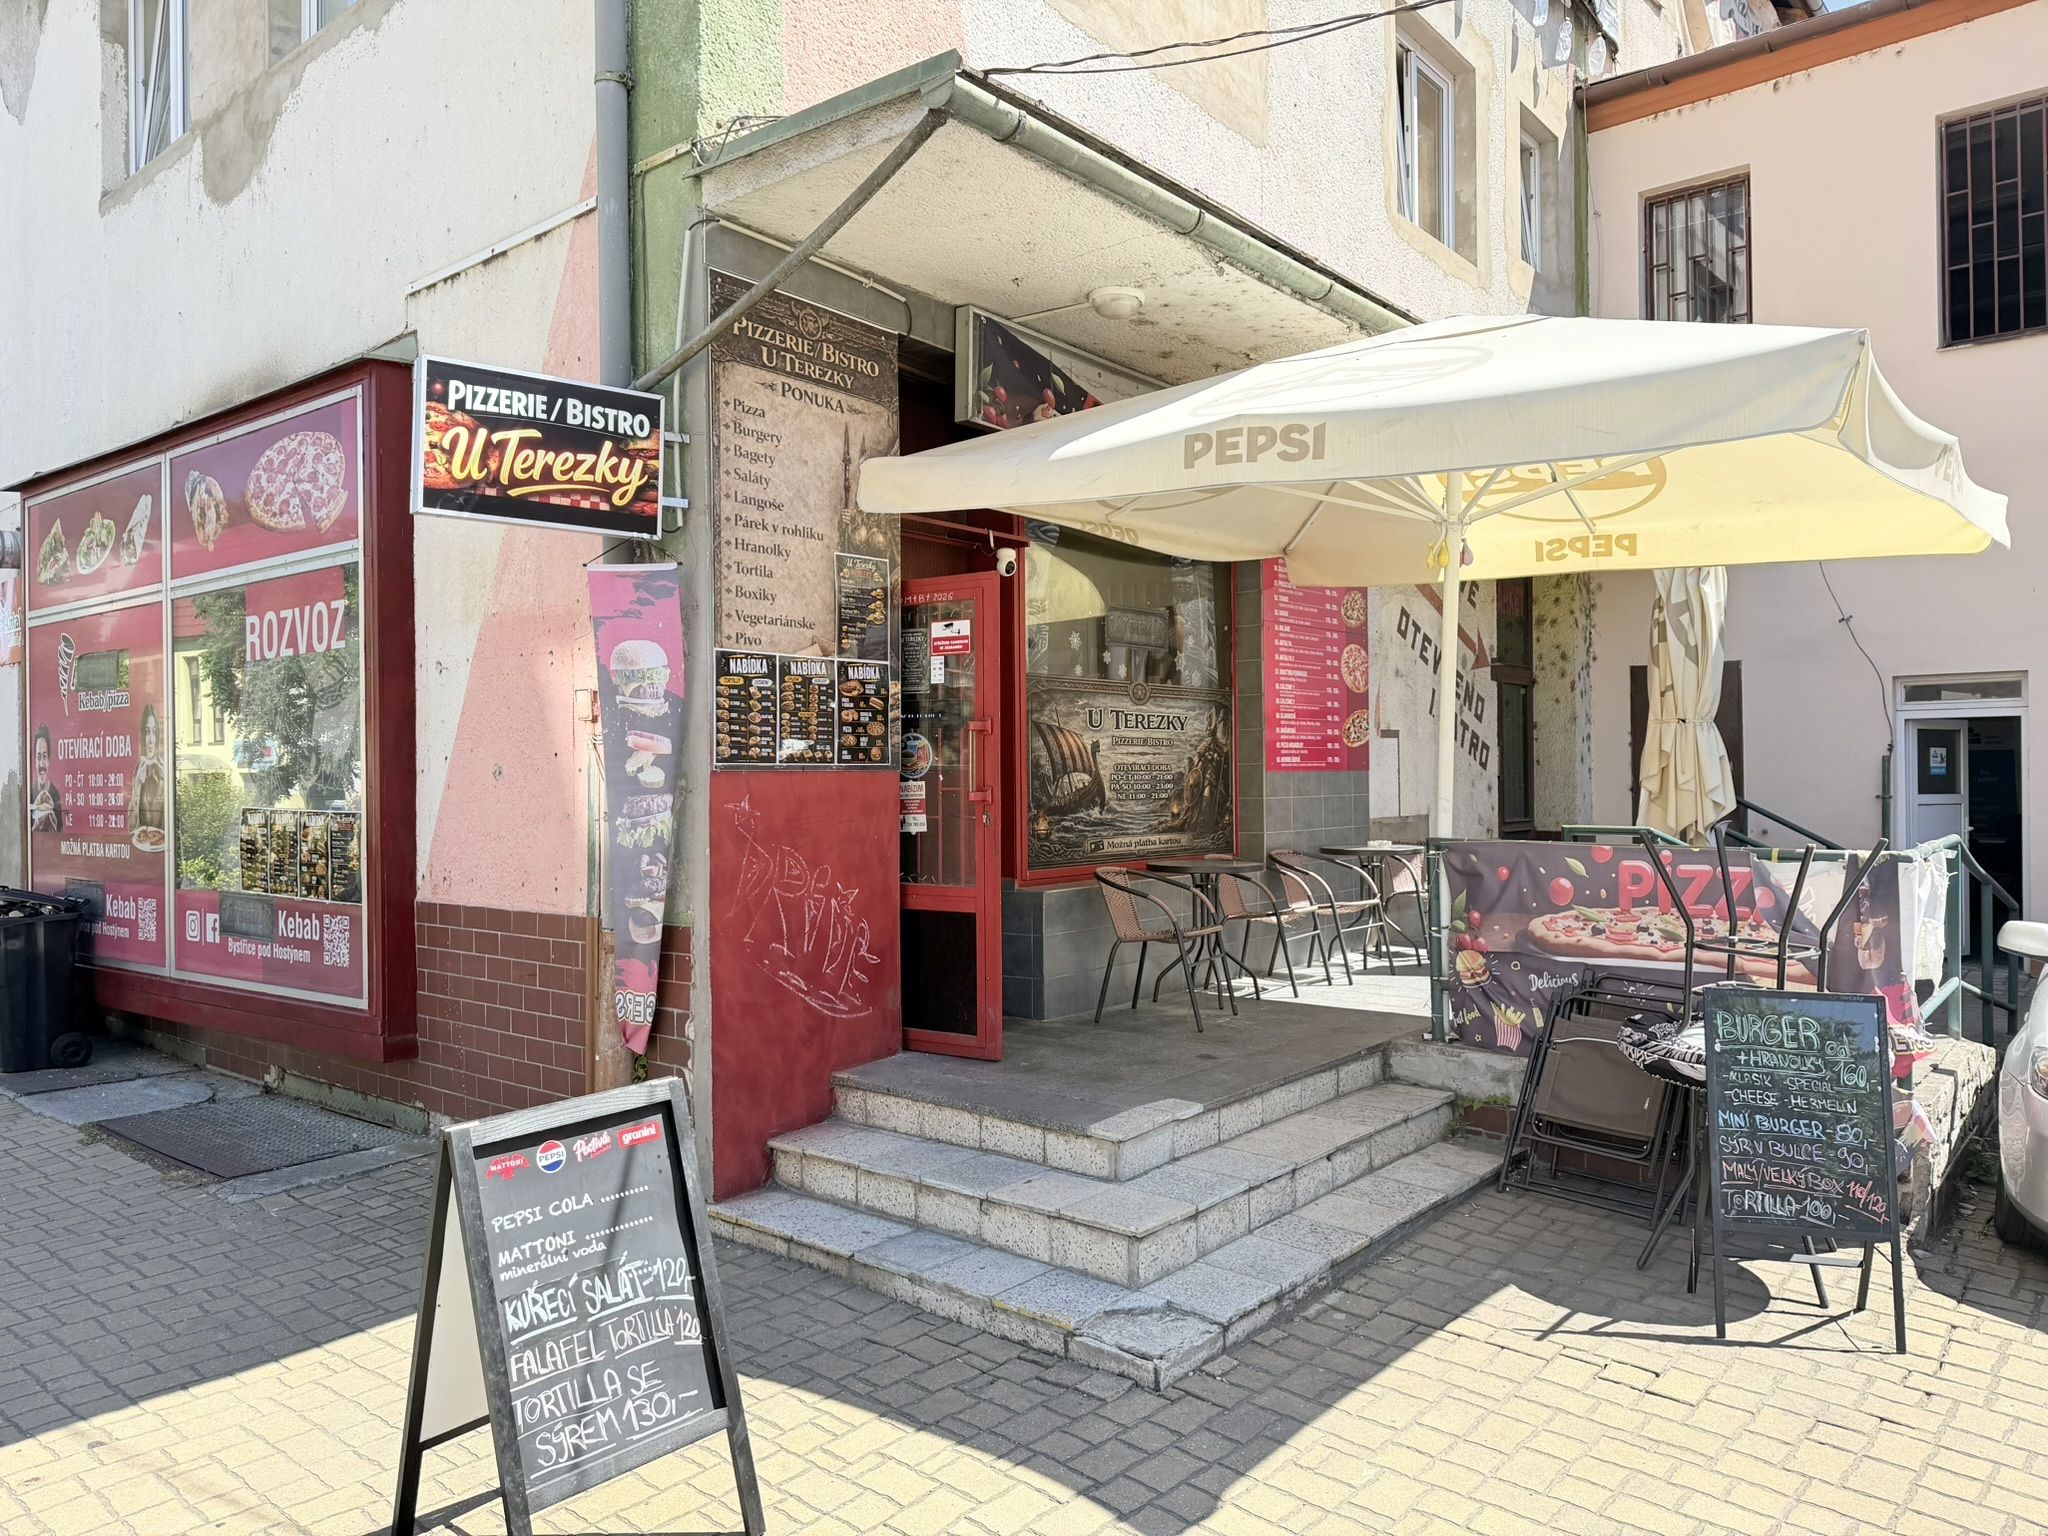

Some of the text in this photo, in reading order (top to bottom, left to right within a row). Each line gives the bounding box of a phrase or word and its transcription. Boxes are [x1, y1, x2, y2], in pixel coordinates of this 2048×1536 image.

[760, 346, 855, 390] U TEREZKY
[448, 379, 548, 420] PIZZERIE
[566, 397, 651, 438] BISTRO
[733, 398, 766, 418] Pizza
[780, 381, 845, 414] PONUKA
[733, 421, 783, 447] Burgery
[1183, 422, 1327, 470] PEPSI
[441, 426, 649, 506] U Terezky
[733, 444, 776, 468] Bagety
[733, 467, 771, 488] Saláty
[734, 491, 785, 513] Langoše
[734, 513, 824, 542] Párek v rohliku
[734, 537, 791, 561] Hranolky
[734, 561, 774, 579] Tortila
[735, 585, 777, 606] Boxiky
[246, 598, 347, 662] ROZVOZ
[735, 609, 816, 631] Vegetariánske
[735, 632, 762, 647] Pivo
[730, 656, 768, 674] NABÍDKA
[790, 660, 827, 675] NABÍDKA
[848, 664, 880, 680] NABÍDKA
[1397, 605, 1486, 724] OTEVENO
[78, 690, 130, 712] Kebab/pizza
[1087, 708, 1188, 731] U TEREZKY
[57, 731, 132, 760] OTEVÍRACÍ DOBA
[82, 842, 104, 857] PLATBA
[105, 843, 131, 859] KARTOU
[105, 894, 136, 920] Kebab
[278, 910, 320, 941] Kebab
[228, 938, 311, 964] Bystřice pod Hostýnem
[1716, 1011, 1821, 1049] BURGER
[1755, 1114, 1824, 1138] BURGER
[490, 1158, 524, 1172] MATTONI
[539, 1151, 565, 1163] PEPSI
[622, 1124, 656, 1144] granini
[1769, 1140, 1826, 1162] BULCE
[1809, 1172, 1844, 1194] BOX
[491, 1192, 594, 1233] PEPSI COLA
[498, 1230, 577, 1267] MATTONI
[500, 1240, 607, 1281] minerální voda
[504, 1272, 579, 1334] KUŘECÍ
[582, 1250, 645, 1315] SALÁT
[510, 1329, 607, 1382] FALAFEL
[512, 1359, 663, 1433] TORTILLA SE
[536, 1406, 622, 1467] SÝREM
